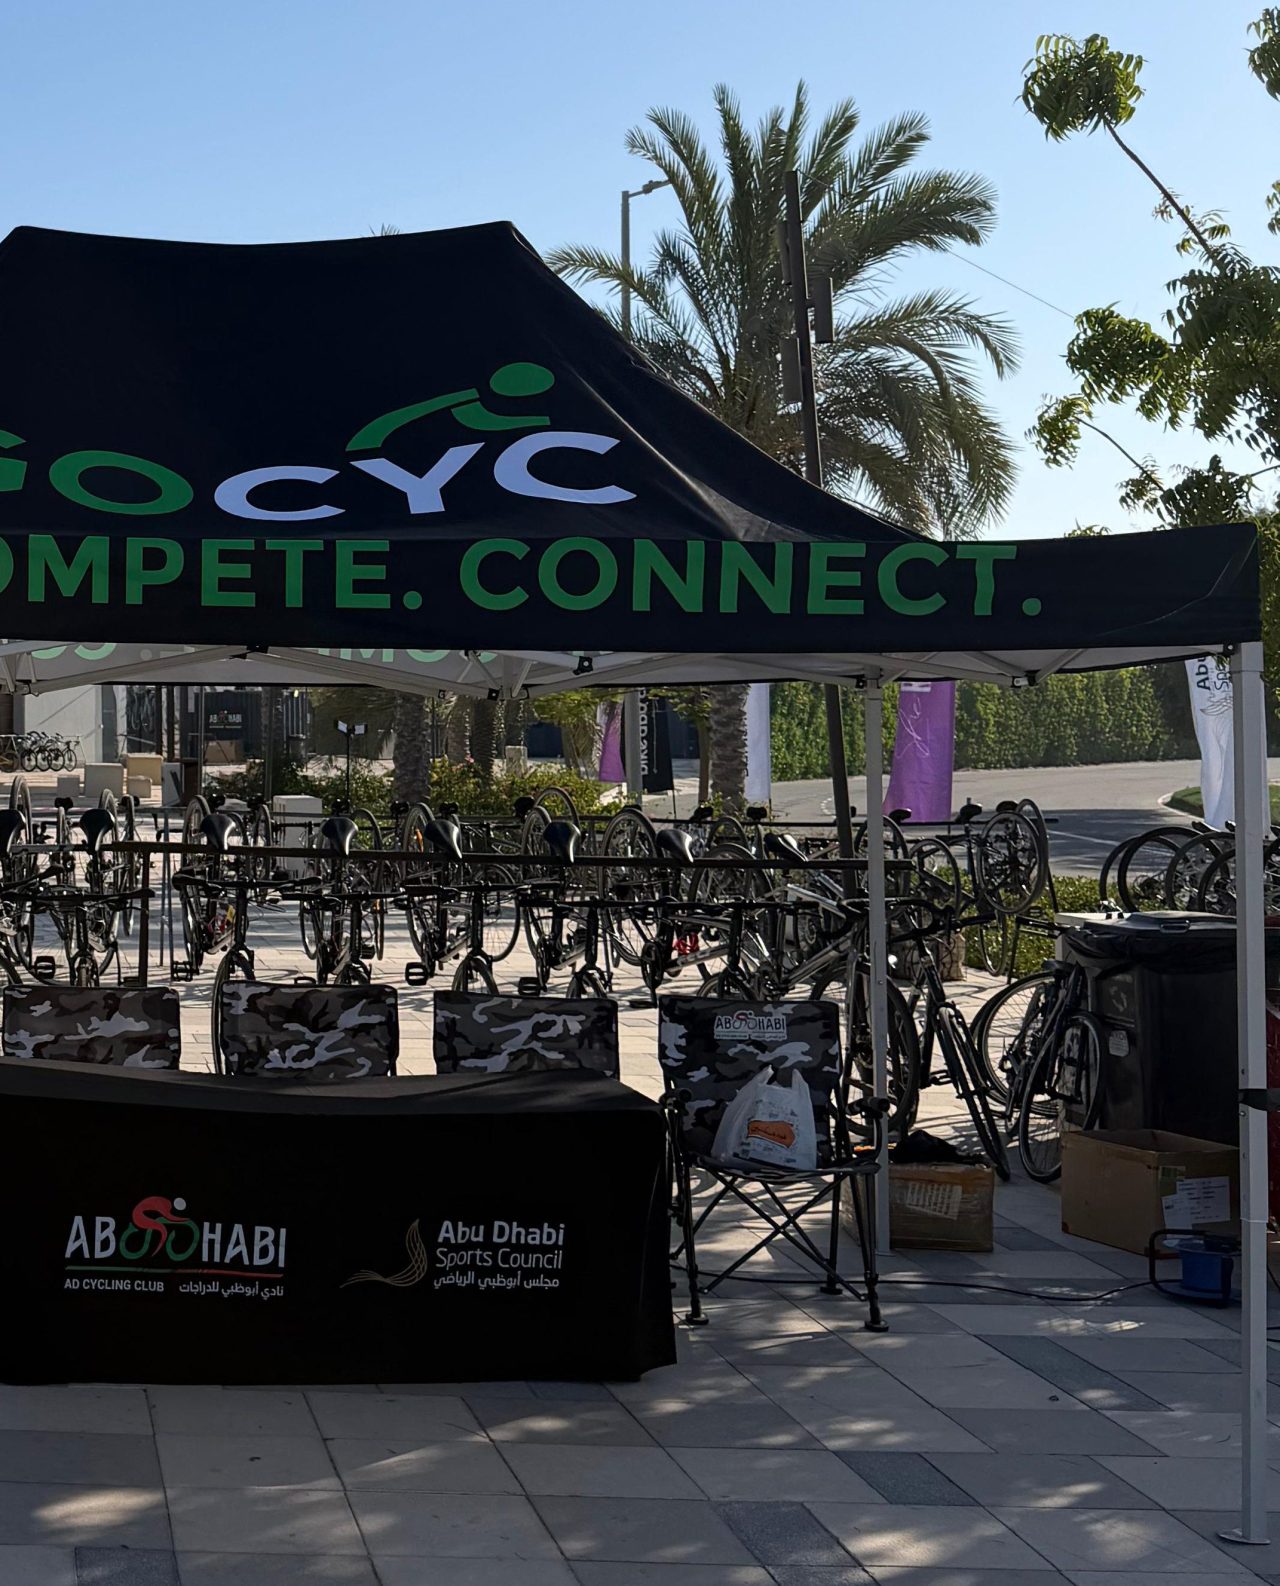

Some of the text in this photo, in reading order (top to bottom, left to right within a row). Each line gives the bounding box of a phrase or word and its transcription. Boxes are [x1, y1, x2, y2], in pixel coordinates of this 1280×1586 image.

[460, 537, 1041, 616] CONNECT.
[437, 1220, 565, 1246] Abu Dhabi
[435, 1247, 563, 1271] Sports Council
[64, 1278, 165, 1292] AD CYCLING CLUB
[179, 1281, 219, 1294] للدراجات
[433, 1271, 475, 1290] الرياضي
[523, 1274, 560, 1290] مجلس
[260, 1285, 284, 1300] نادي
